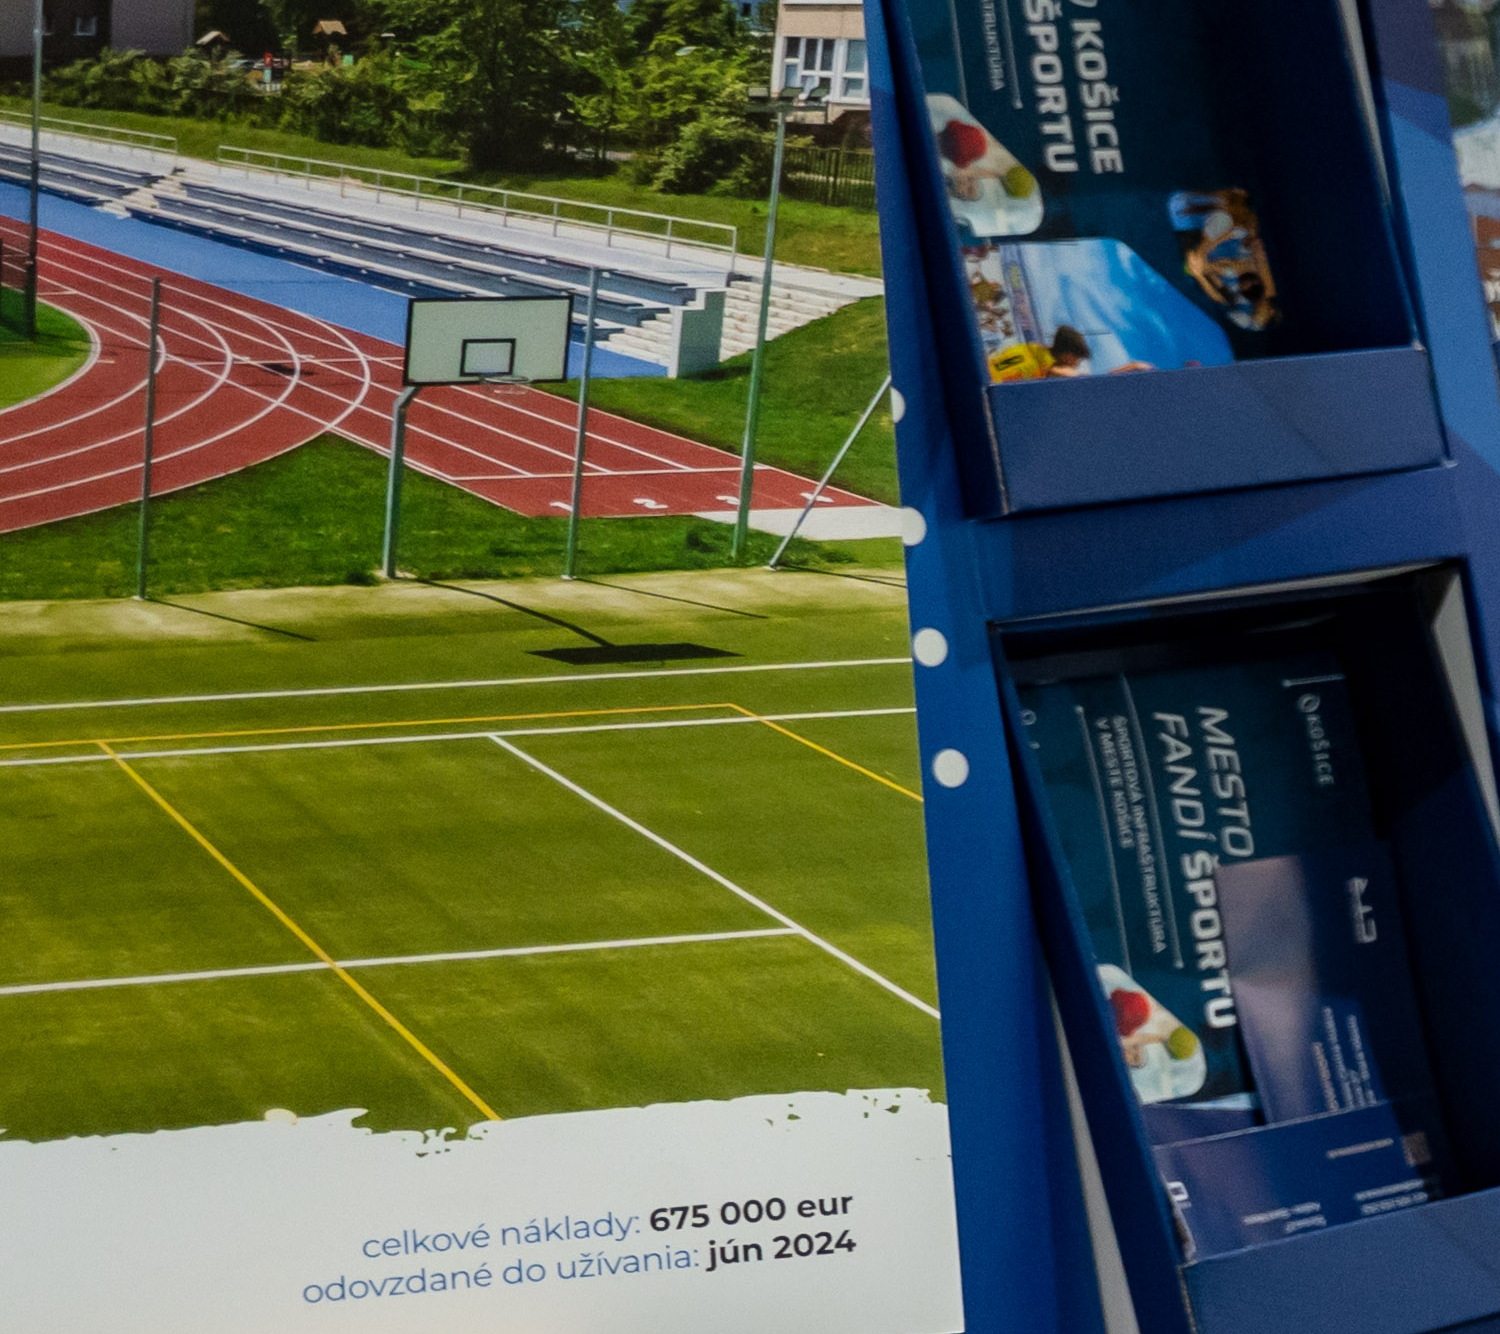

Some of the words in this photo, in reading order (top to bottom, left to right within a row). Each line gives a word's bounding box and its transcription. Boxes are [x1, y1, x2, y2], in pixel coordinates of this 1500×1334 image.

[1071, 19, 1124, 174] KOŠICE
[1152, 711, 1218, 843] FANDÍ
[1196, 705, 1255, 858] MESTO
[1180, 849, 1237, 1030] ŠPORTU
[303, 1265, 494, 1304] odovzdané
[503, 1257, 547, 1286] do
[557, 1243, 701, 1280] užívania:
[704, 1238, 764, 1273] jún
[773, 1227, 857, 1259] 2024
[362, 1223, 491, 1259] celkové
[501, 1210, 642, 1247] náklady:
[649, 1204, 711, 1233] 675
[720, 1197, 787, 1226] 000
[796, 1193, 854, 1219] eur
